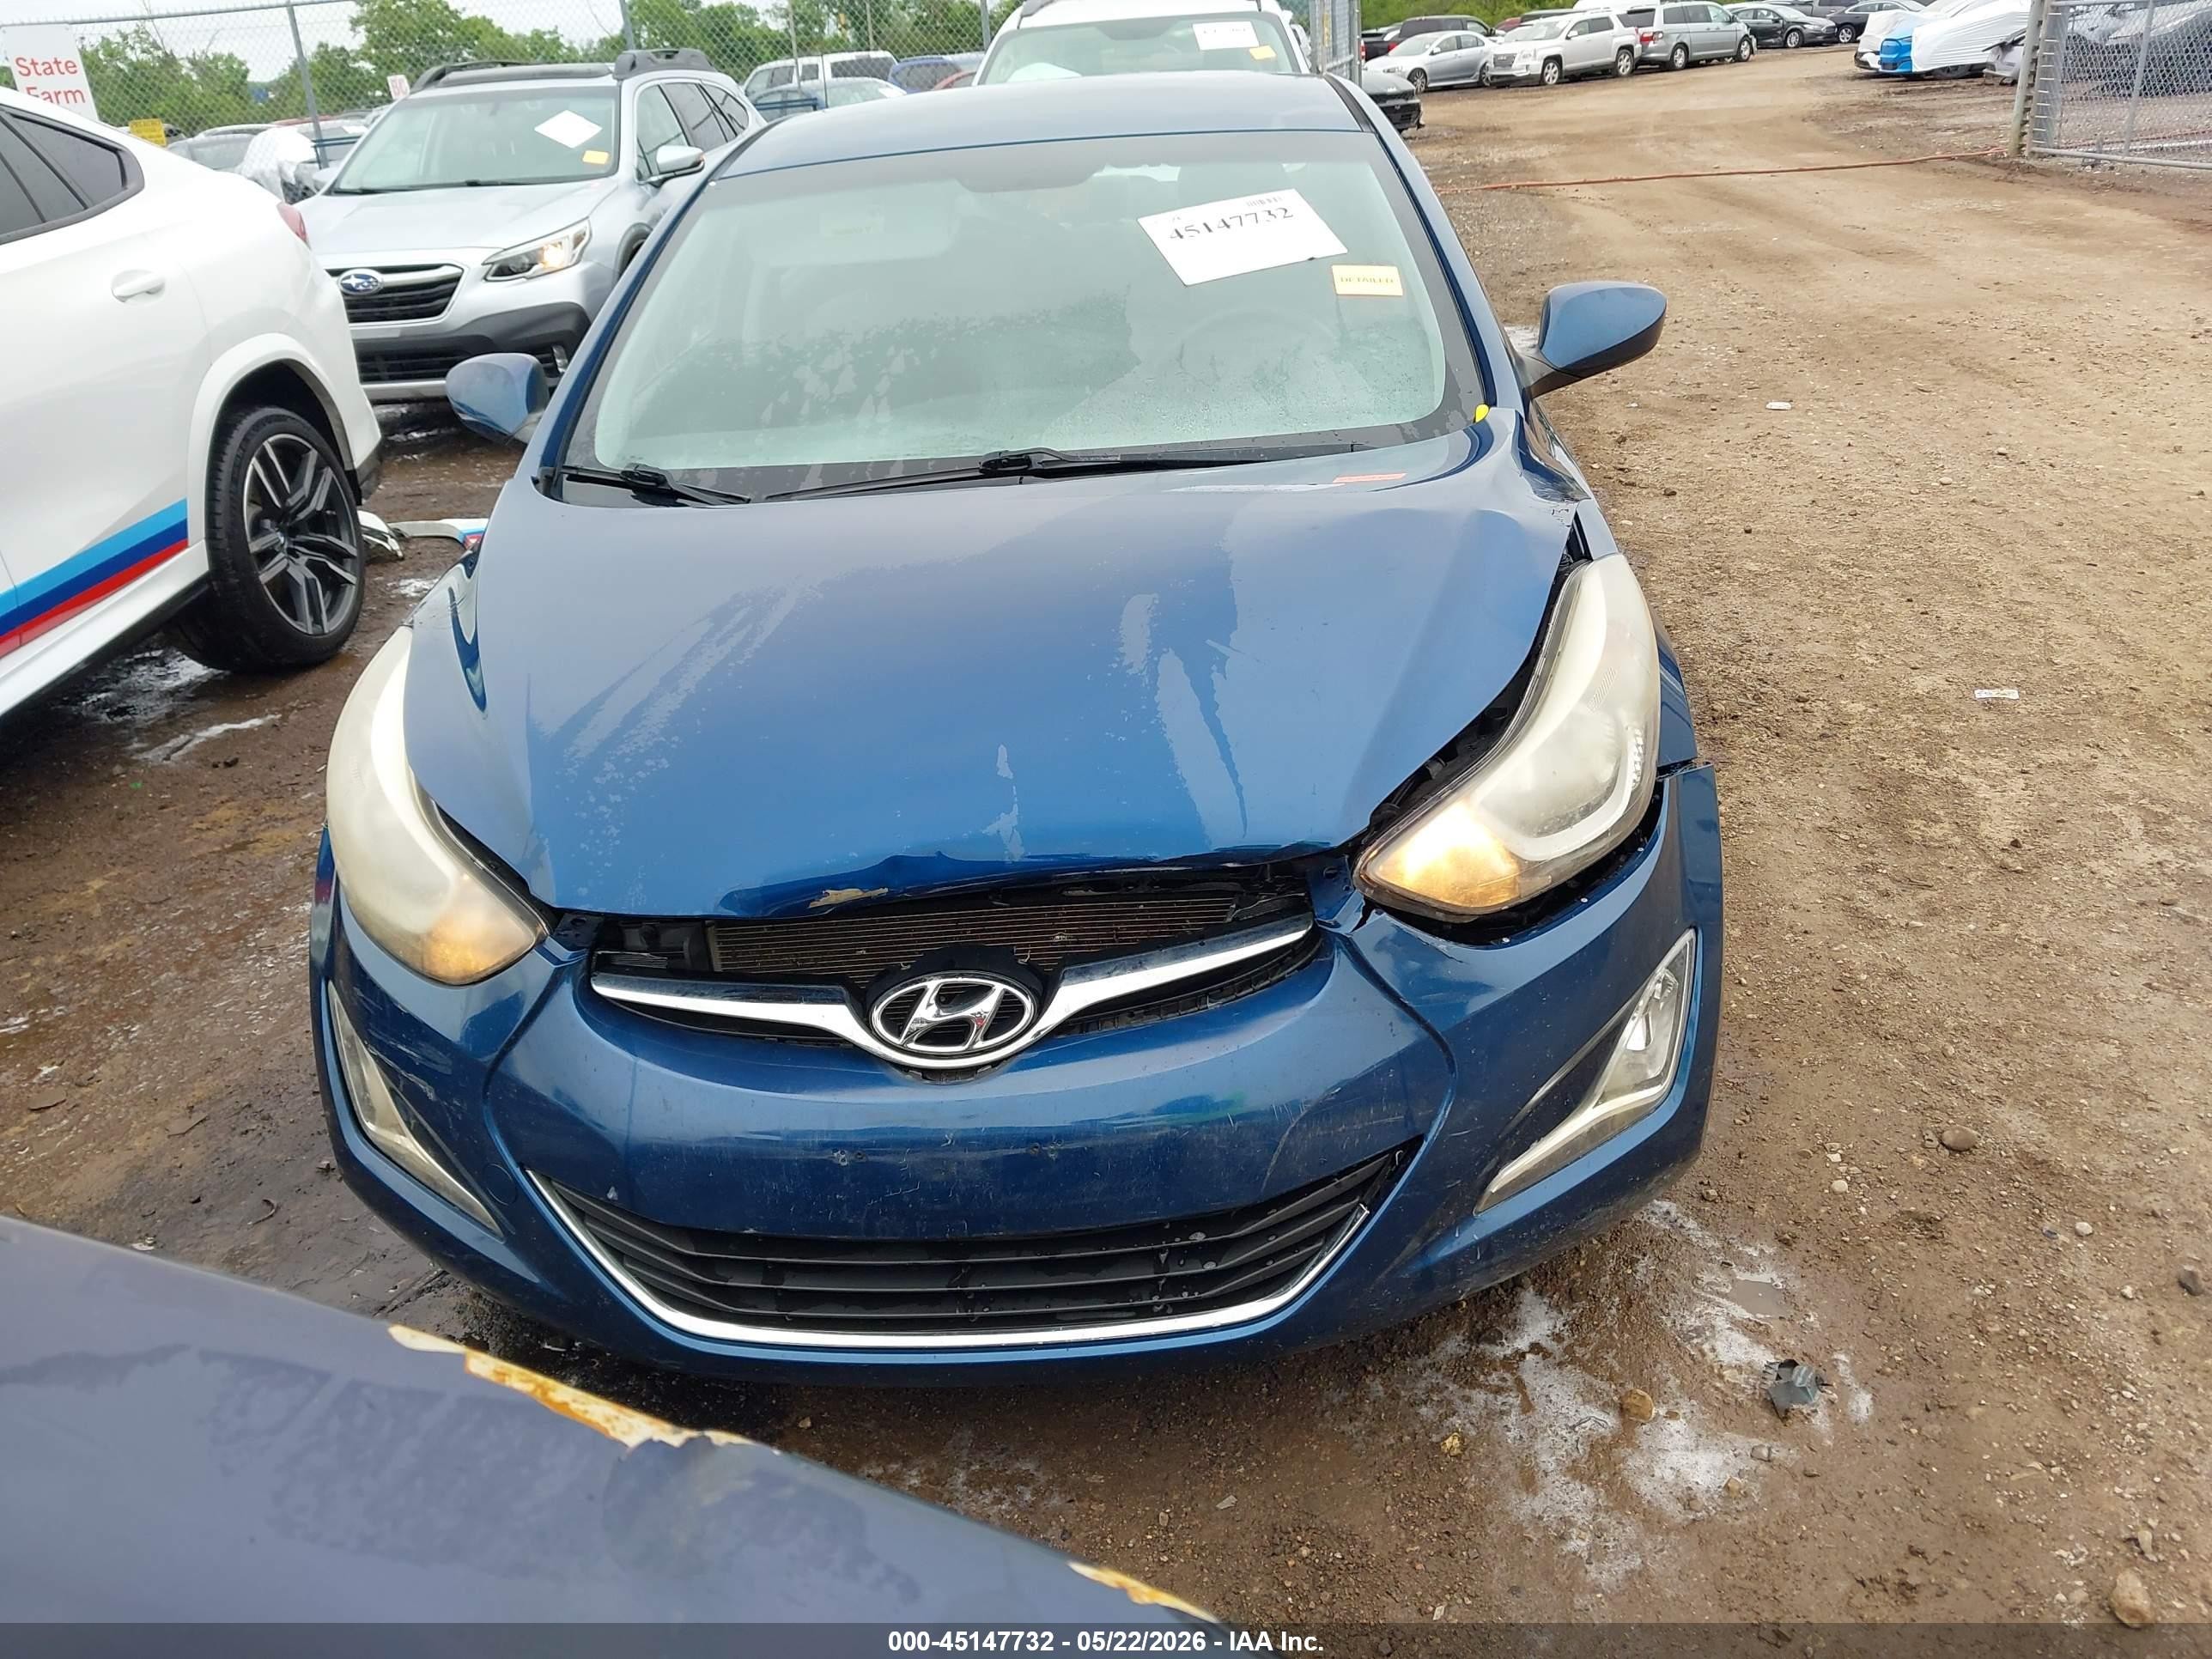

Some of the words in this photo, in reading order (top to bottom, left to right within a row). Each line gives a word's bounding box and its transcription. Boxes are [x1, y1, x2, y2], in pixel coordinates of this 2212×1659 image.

[15, 57, 78, 77] State
[25, 87, 86, 105] Farm
[1169, 206, 1294, 240] 45147732
